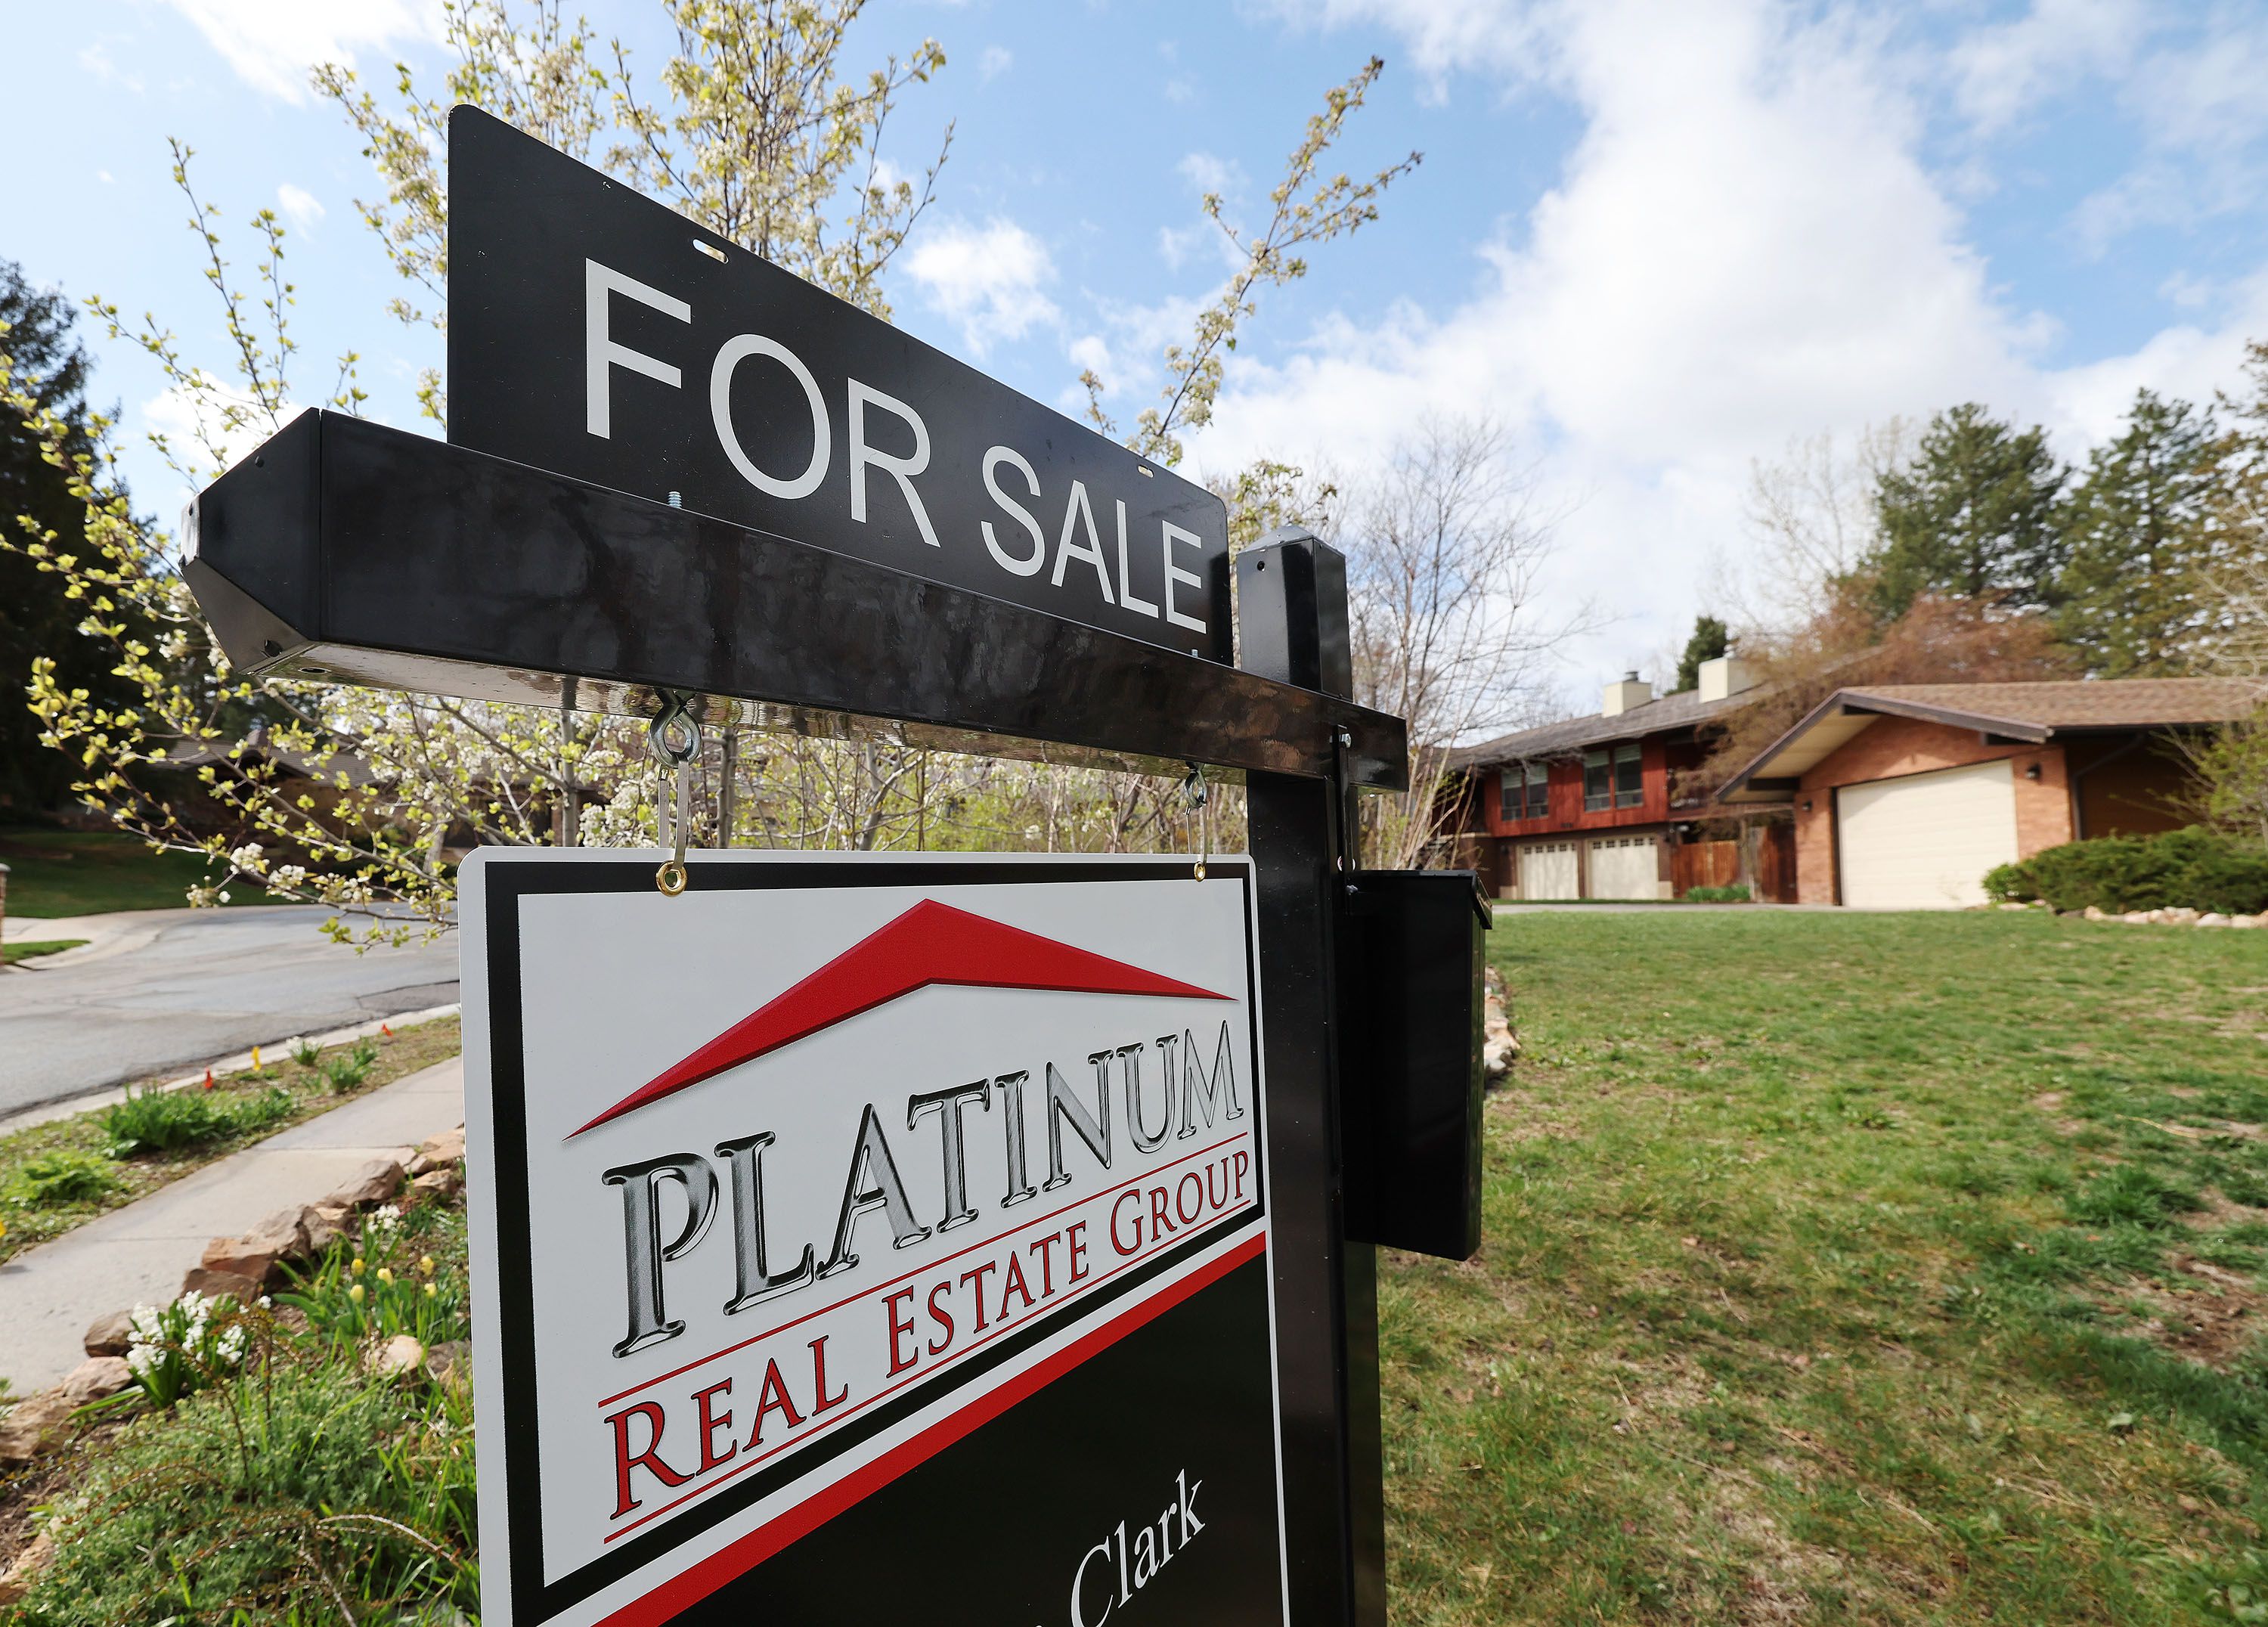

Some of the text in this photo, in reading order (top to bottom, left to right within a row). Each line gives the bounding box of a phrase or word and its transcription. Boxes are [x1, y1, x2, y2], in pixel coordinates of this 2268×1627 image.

[585, 257, 1207, 633] FOR SALE
[603, 1020, 1244, 1359] PLATINUM
[604, 1150, 1249, 1521] REAL ESTATE GROUP
[1070, 1468, 1206, 1627] Clark
